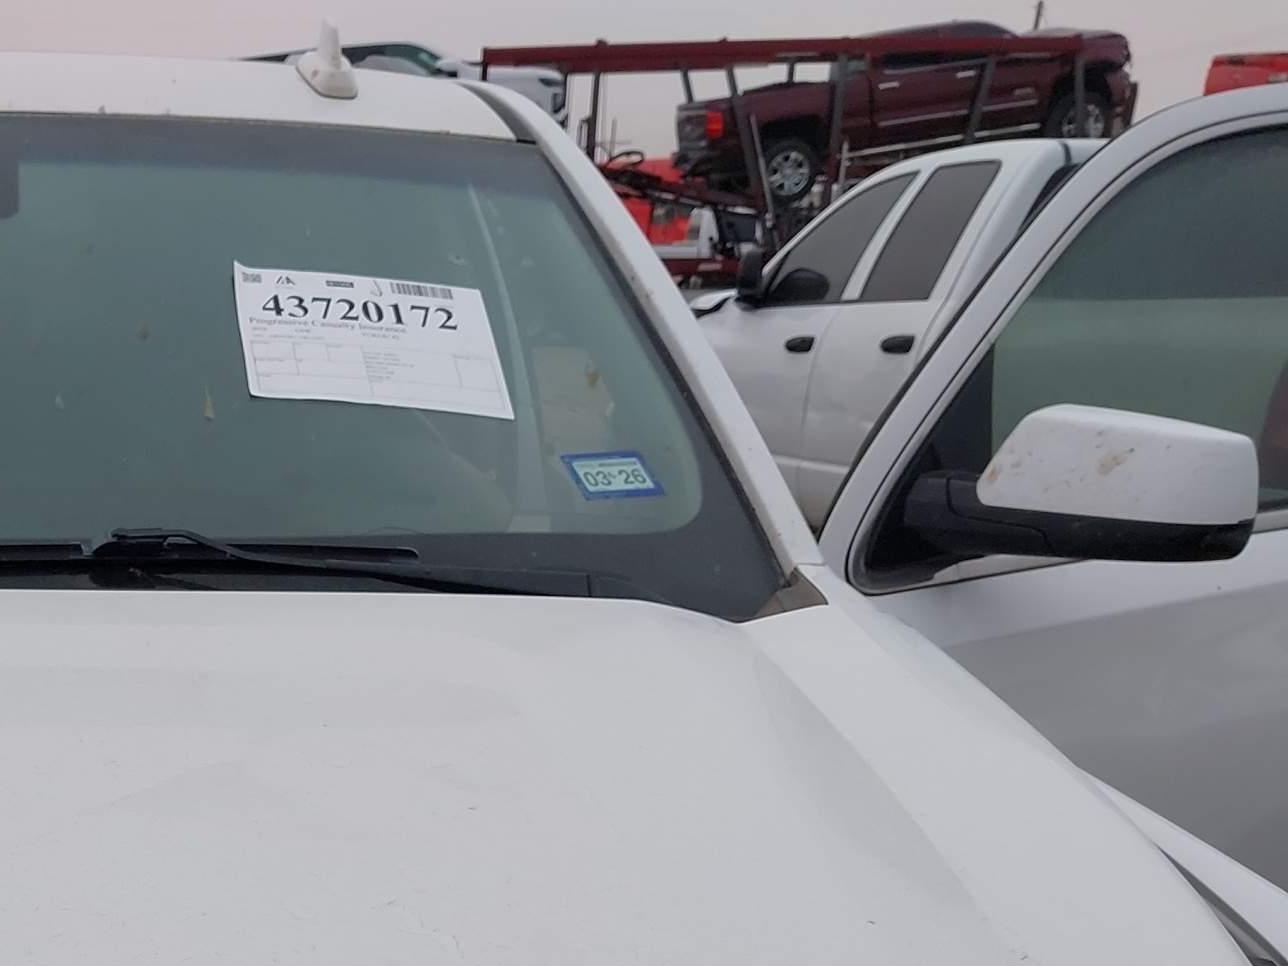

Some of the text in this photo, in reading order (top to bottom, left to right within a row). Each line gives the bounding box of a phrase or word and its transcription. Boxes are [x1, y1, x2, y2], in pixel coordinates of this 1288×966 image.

[262, 294, 458, 330] 43720172
[583, 470, 612, 487] 03
[617, 468, 647, 485] 26
